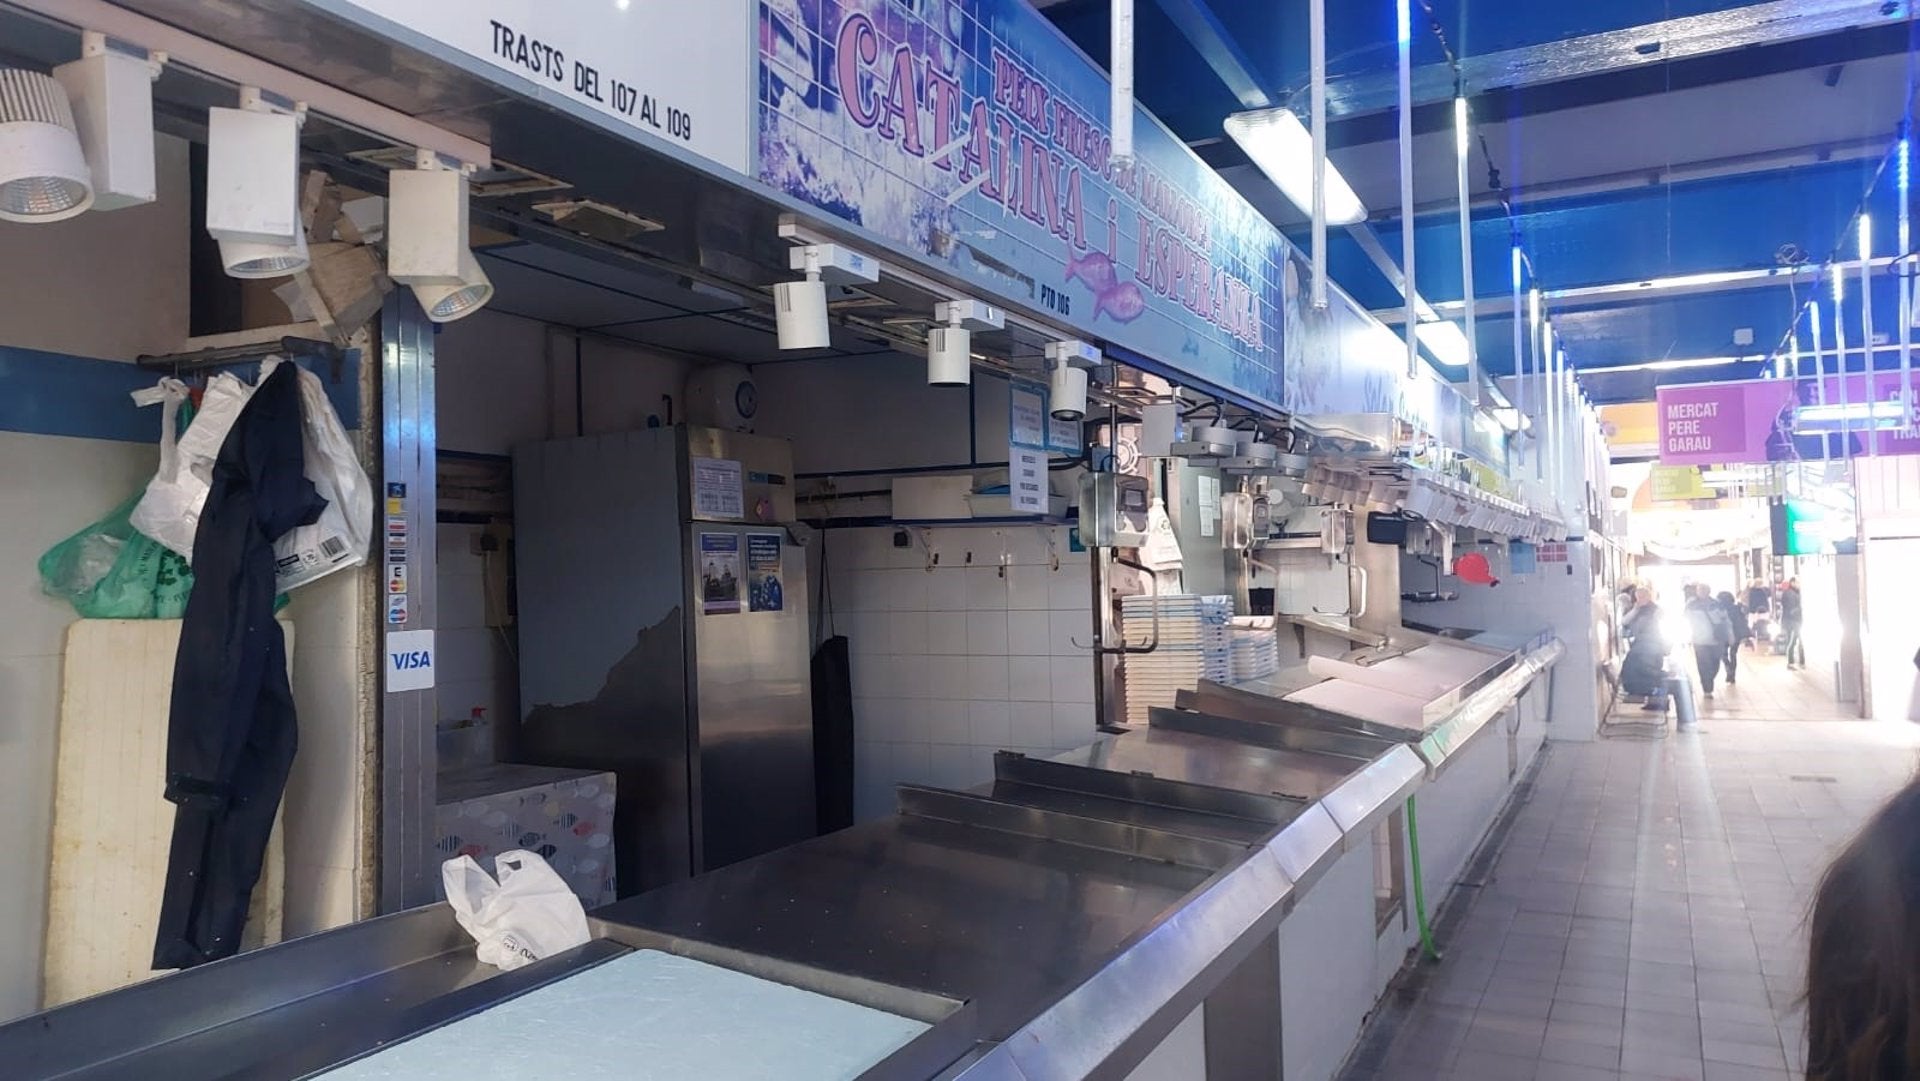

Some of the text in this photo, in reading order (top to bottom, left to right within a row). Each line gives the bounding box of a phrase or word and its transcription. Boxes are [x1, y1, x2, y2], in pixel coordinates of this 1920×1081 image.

[490, 20, 691, 140] TRASTS DEL 107 AL 109
[994, 49, 1049, 135] PEIX
[836, 13, 1087, 250] CATALINA
[1041, 284, 1071, 316] PTO 106
[1668, 402, 1720, 419] MERCAT
[1668, 420, 1700, 435] PERE
[1669, 436, 1711, 452] GARAU
[390, 651, 431, 670] VISA
